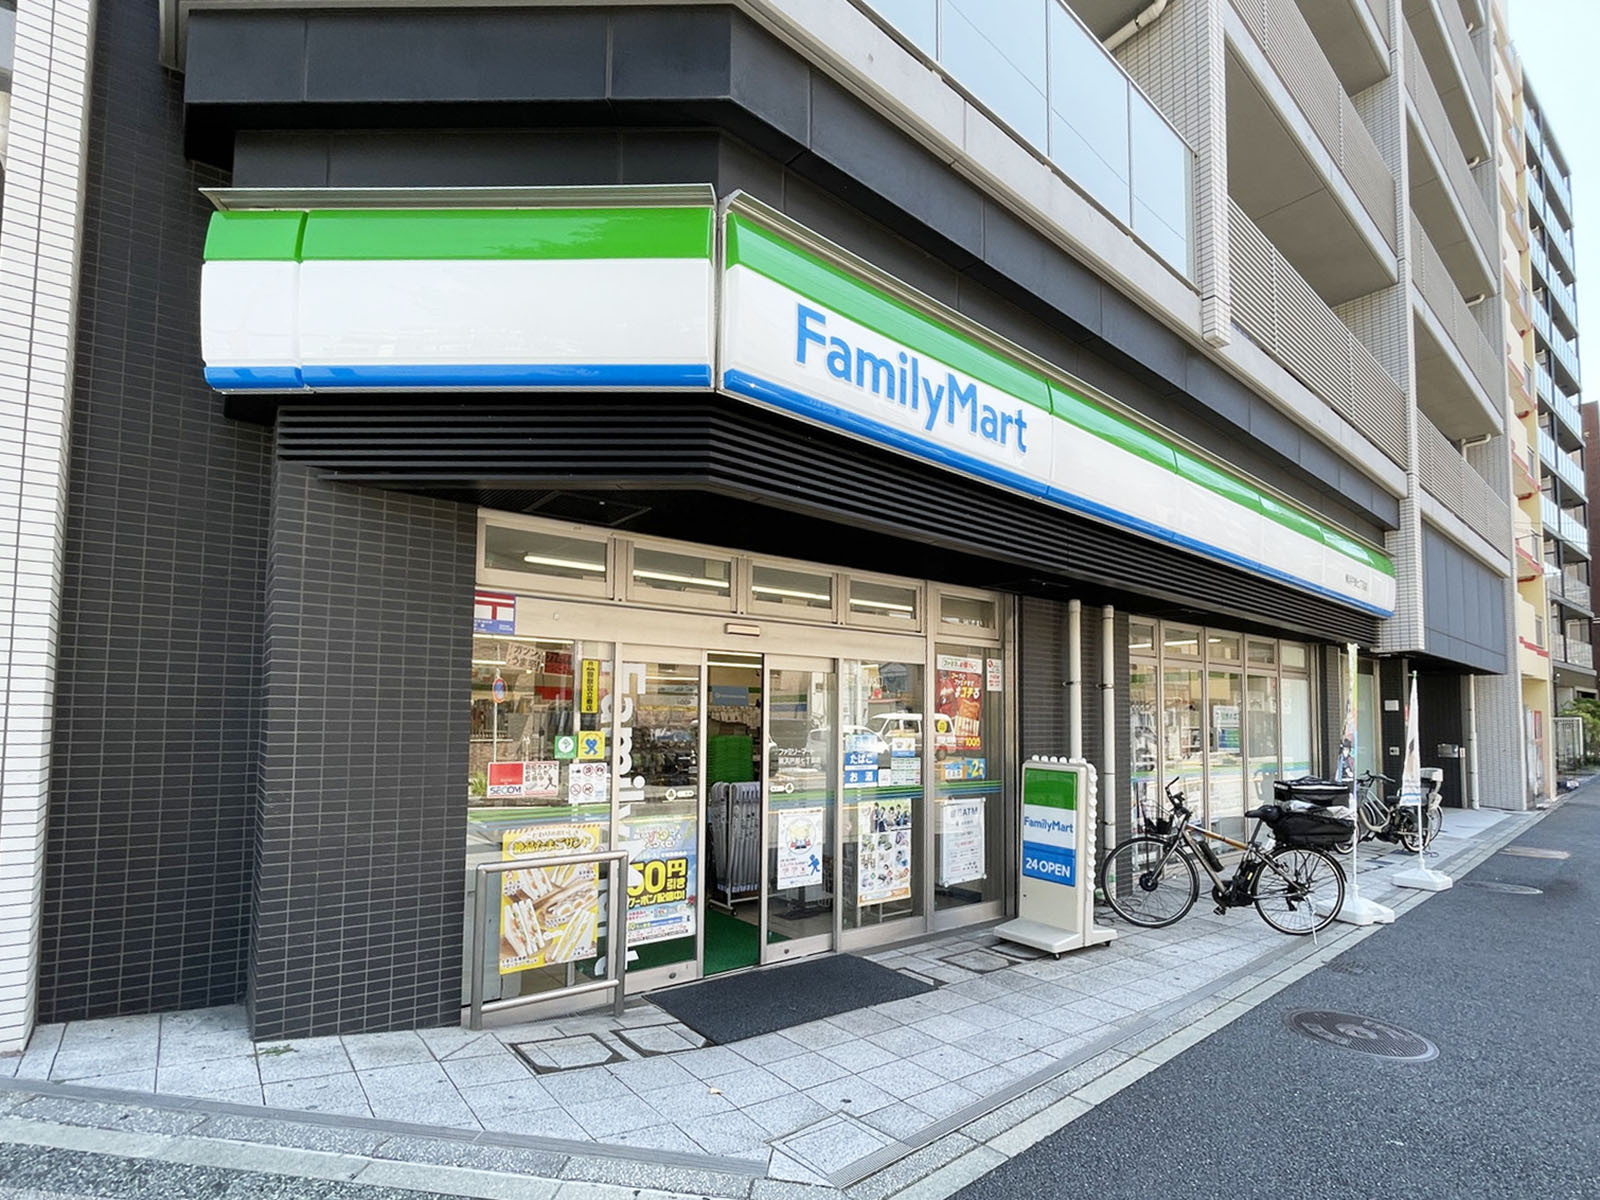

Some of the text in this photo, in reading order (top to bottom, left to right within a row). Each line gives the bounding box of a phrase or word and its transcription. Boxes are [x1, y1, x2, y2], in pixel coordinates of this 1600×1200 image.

[795, 302, 1028, 454] FamilyMart
[850, 753, 873, 765] たばこ
[489, 785, 522, 795] SECOM
[1024, 816, 1074, 833] FamilyMart
